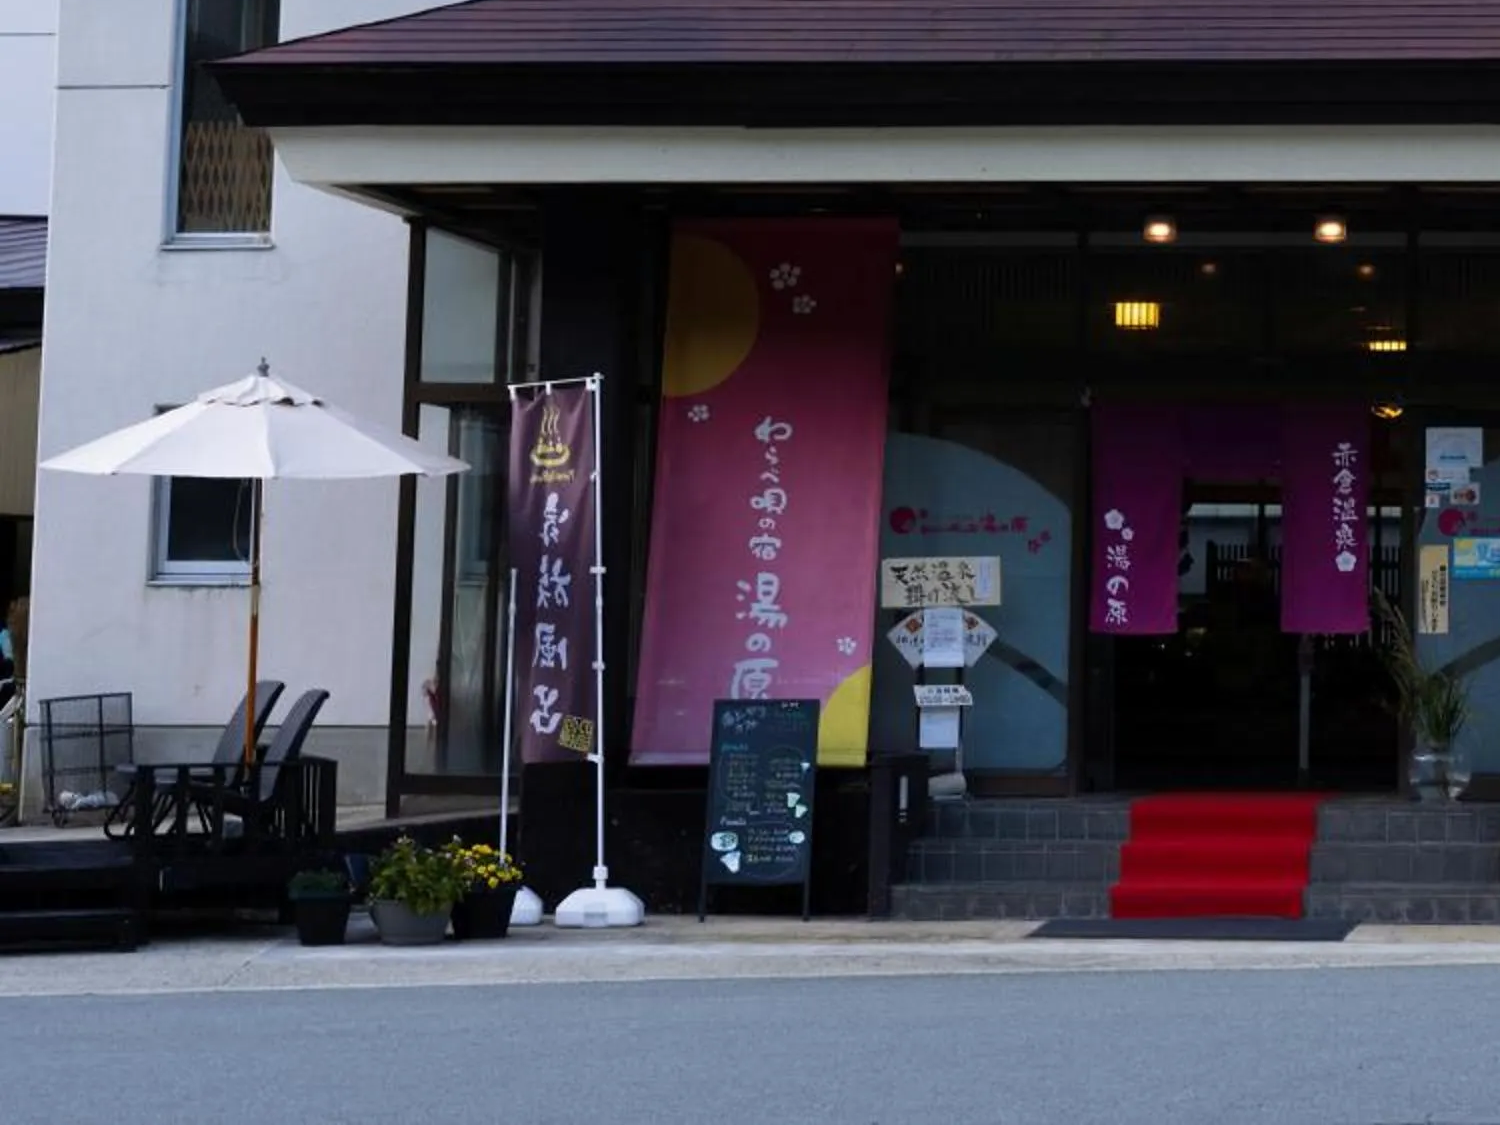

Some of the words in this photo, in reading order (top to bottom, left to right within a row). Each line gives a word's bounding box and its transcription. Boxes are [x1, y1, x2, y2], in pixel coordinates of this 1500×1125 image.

[1332, 442, 1359, 551] 赤倉温泉
[891, 560, 976, 584] 天然温泉
[1105, 544, 1131, 626] 湯の原
[731, 571, 787, 699] 湯の原
